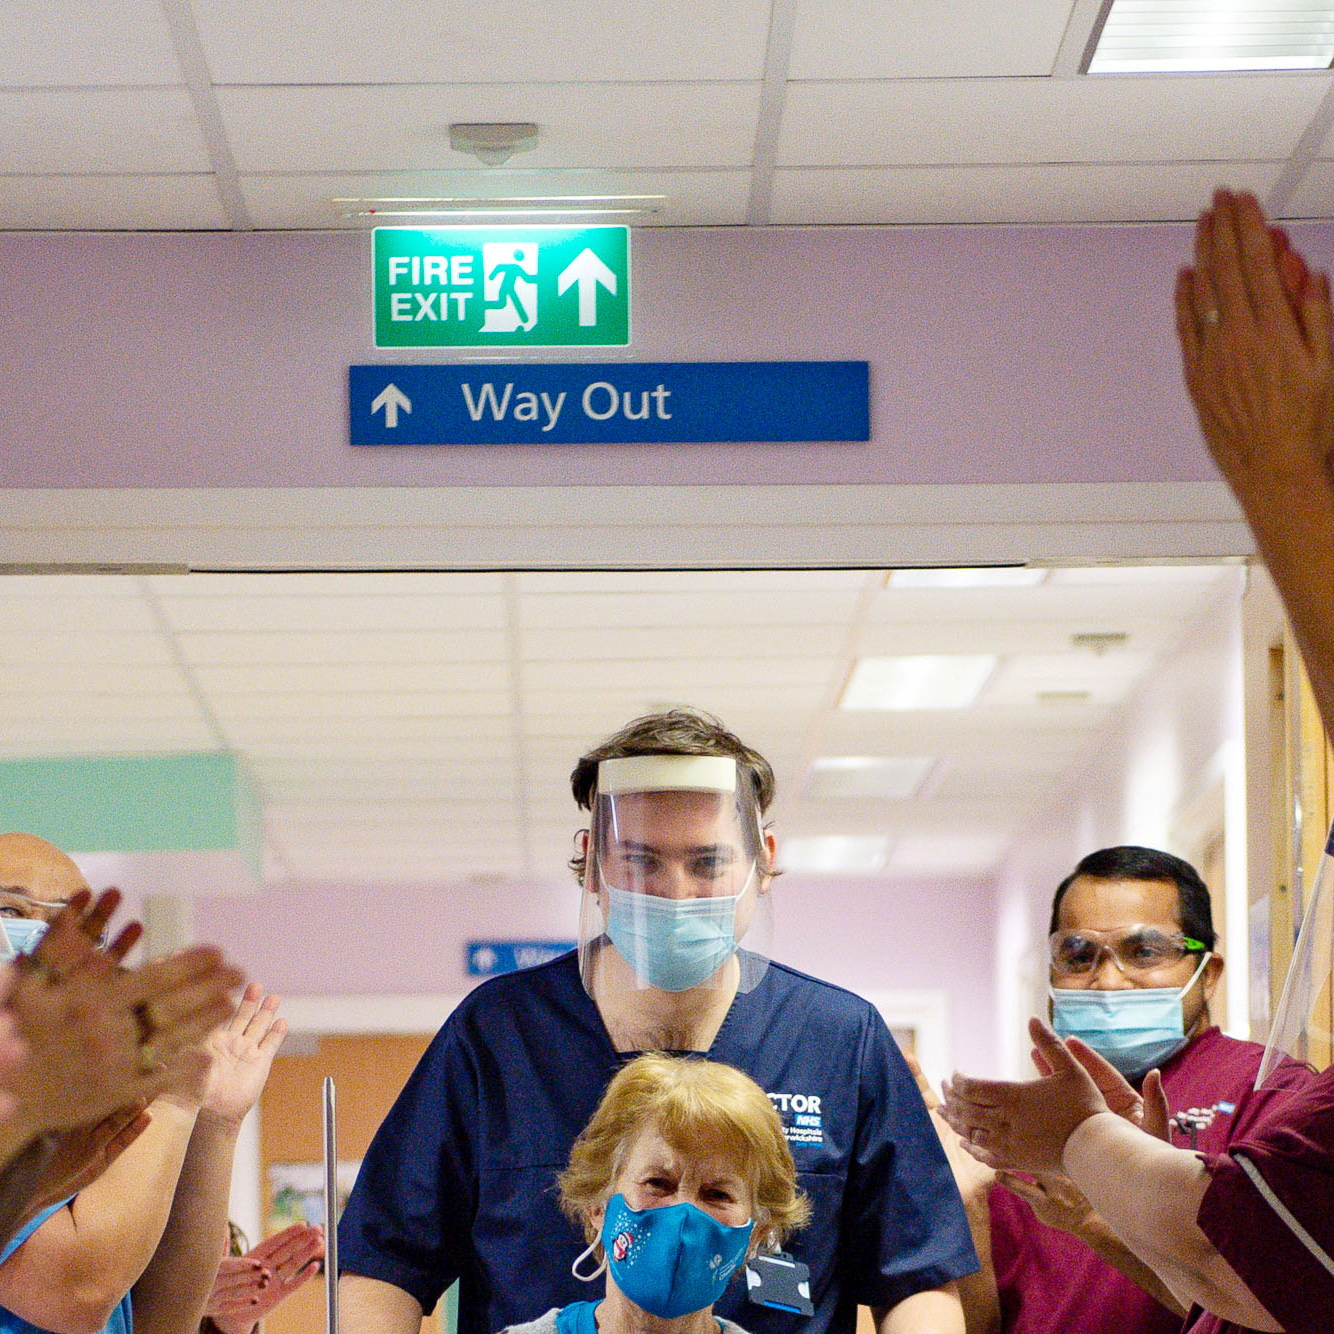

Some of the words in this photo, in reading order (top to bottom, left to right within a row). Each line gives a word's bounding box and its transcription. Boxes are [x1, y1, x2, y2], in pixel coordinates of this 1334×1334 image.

[388, 255, 474, 286] FIRE
[390, 292, 474, 321] EXIT
[460, 382, 567, 432] Way
[582, 381, 673, 420] Out
[766, 1092, 822, 1114] CTOR
[796, 1114, 822, 1127] NHS
